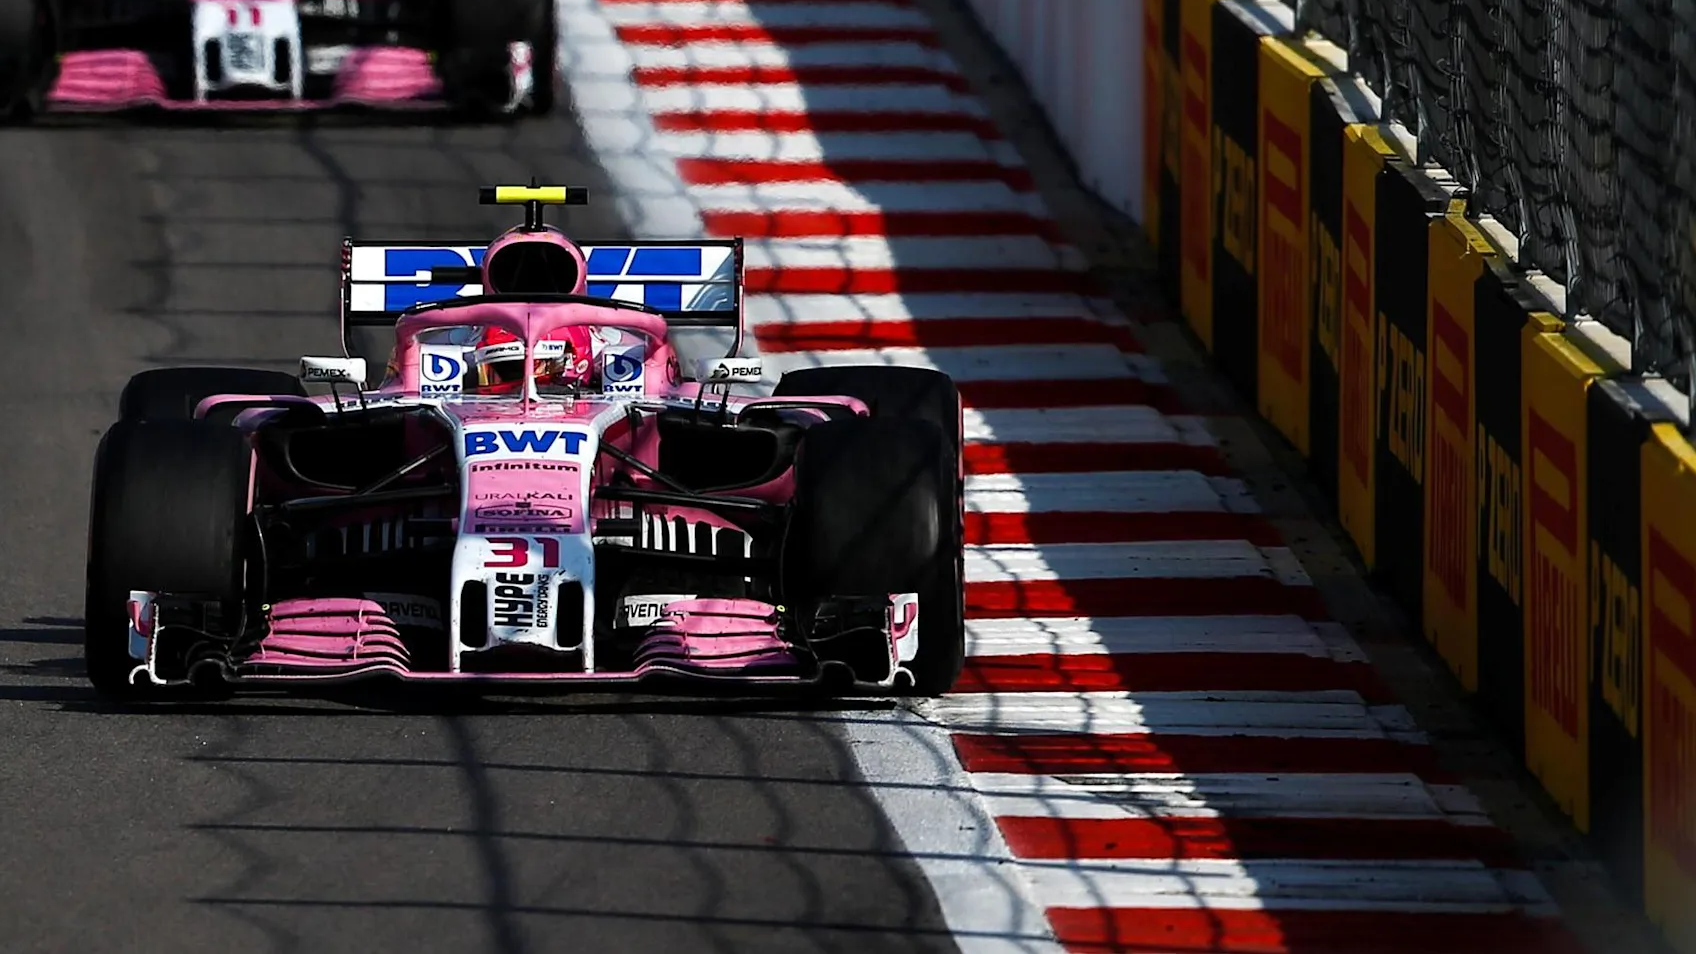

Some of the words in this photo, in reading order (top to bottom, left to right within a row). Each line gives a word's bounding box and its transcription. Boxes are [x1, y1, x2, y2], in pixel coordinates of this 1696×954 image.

[385, 249, 701, 311] BT
[307, 368, 346, 377] PEMEX
[732, 367, 762, 377] PEMEX
[421, 384, 461, 392] BWT
[604, 384, 643, 392] BWT
[1388, 322, 1424, 486] ZERO
[465, 430, 588, 457] BWT
[472, 462, 578, 472] infinitum
[475, 492, 573, 500] URALKALI
[483, 509, 565, 517] SOFINA
[1488, 433, 1521, 608] ZERO
[484, 537, 559, 567] 31
[494, 572, 534, 627] HYPE
[1602, 549, 1640, 741] ZERO
